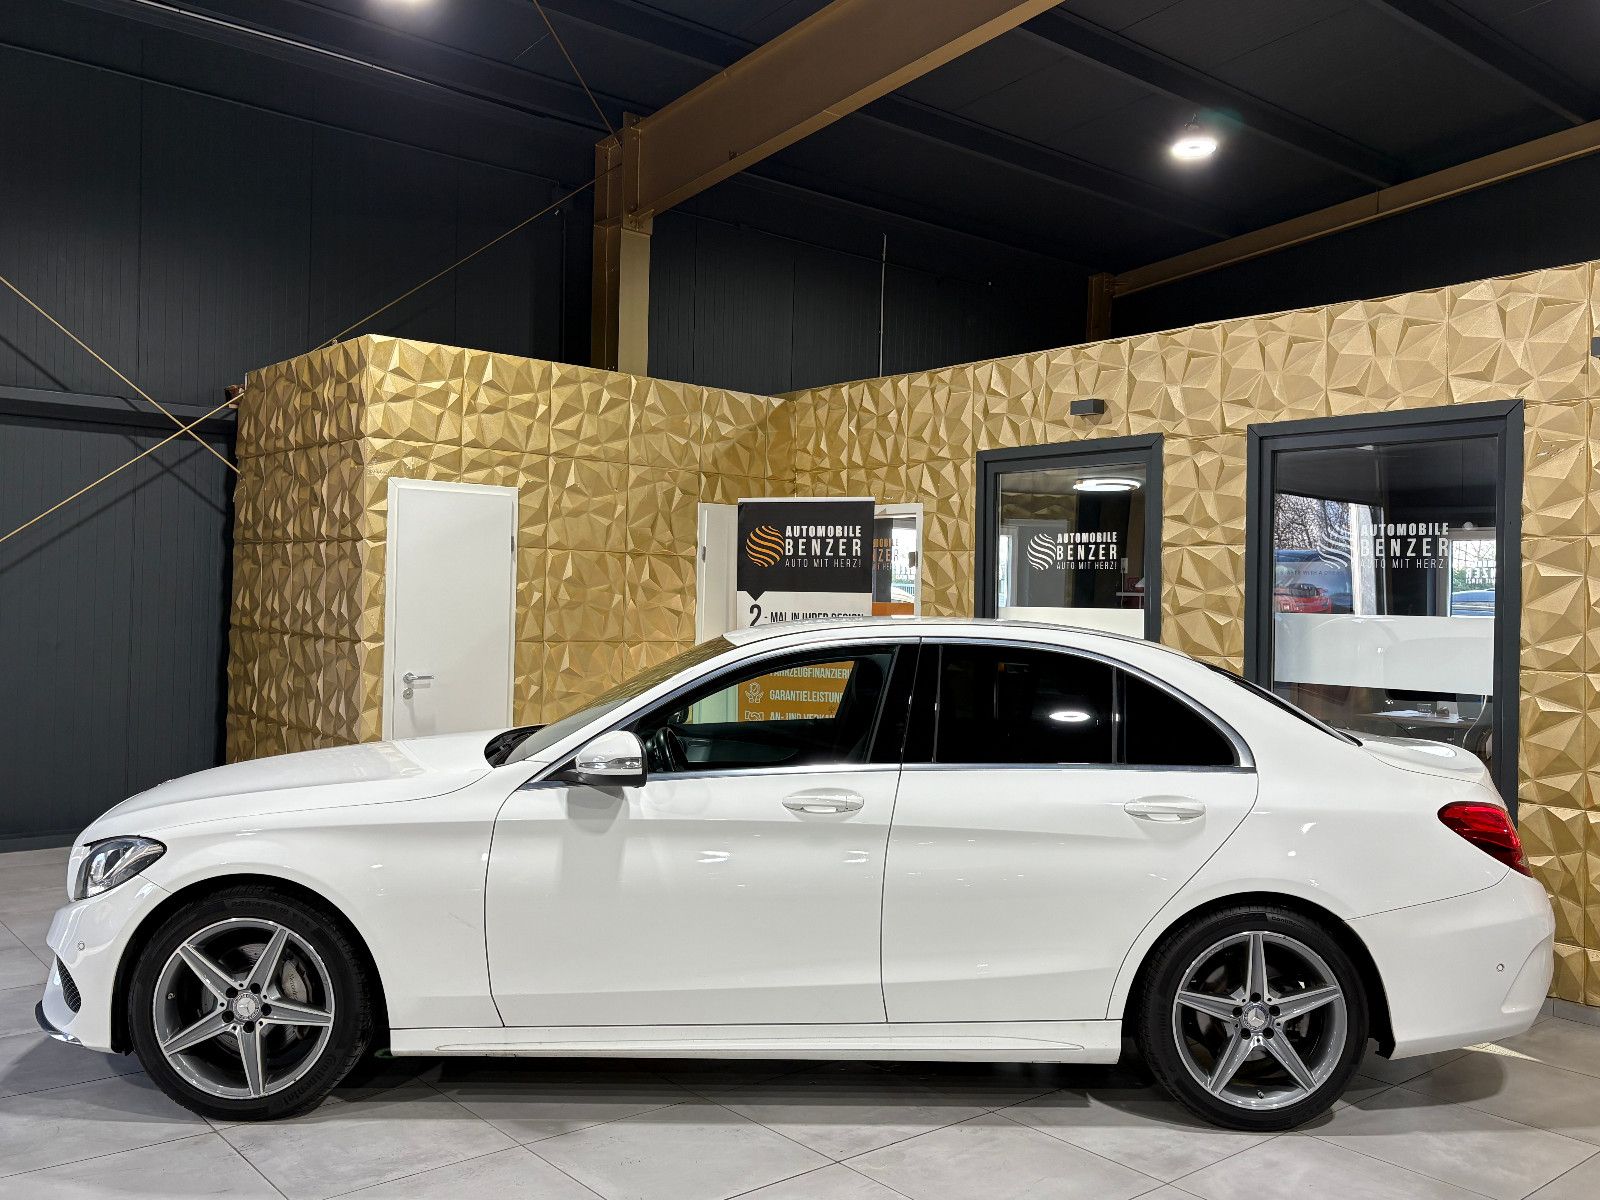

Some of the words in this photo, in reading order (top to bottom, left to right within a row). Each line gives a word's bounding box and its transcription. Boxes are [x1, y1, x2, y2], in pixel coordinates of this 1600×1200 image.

[785, 525, 861, 537] AUTOMOBILE
[1360, 522, 1449, 537] AUTOMOBILE
[1056, 531, 1117, 544] AUTOMOBILE
[785, 538, 861, 556] BENZER
[1056, 544, 1117, 560] BENZER
[1360, 537, 1448, 557] BENZER
[785, 558, 808, 568] AUTO
[813, 558, 829, 568] MIT
[833, 558, 861, 568] HERZ!
[1056, 561, 1075, 570] AUTO
[1078, 561, 1091, 570] MIT
[1094, 561, 1117, 570] HERZ!
[1360, 558, 1386, 569] AUTO
[1392, 558, 1410, 569] MIT
[749, 604, 762, 627] 2
[770, 611, 787, 623] MAL
